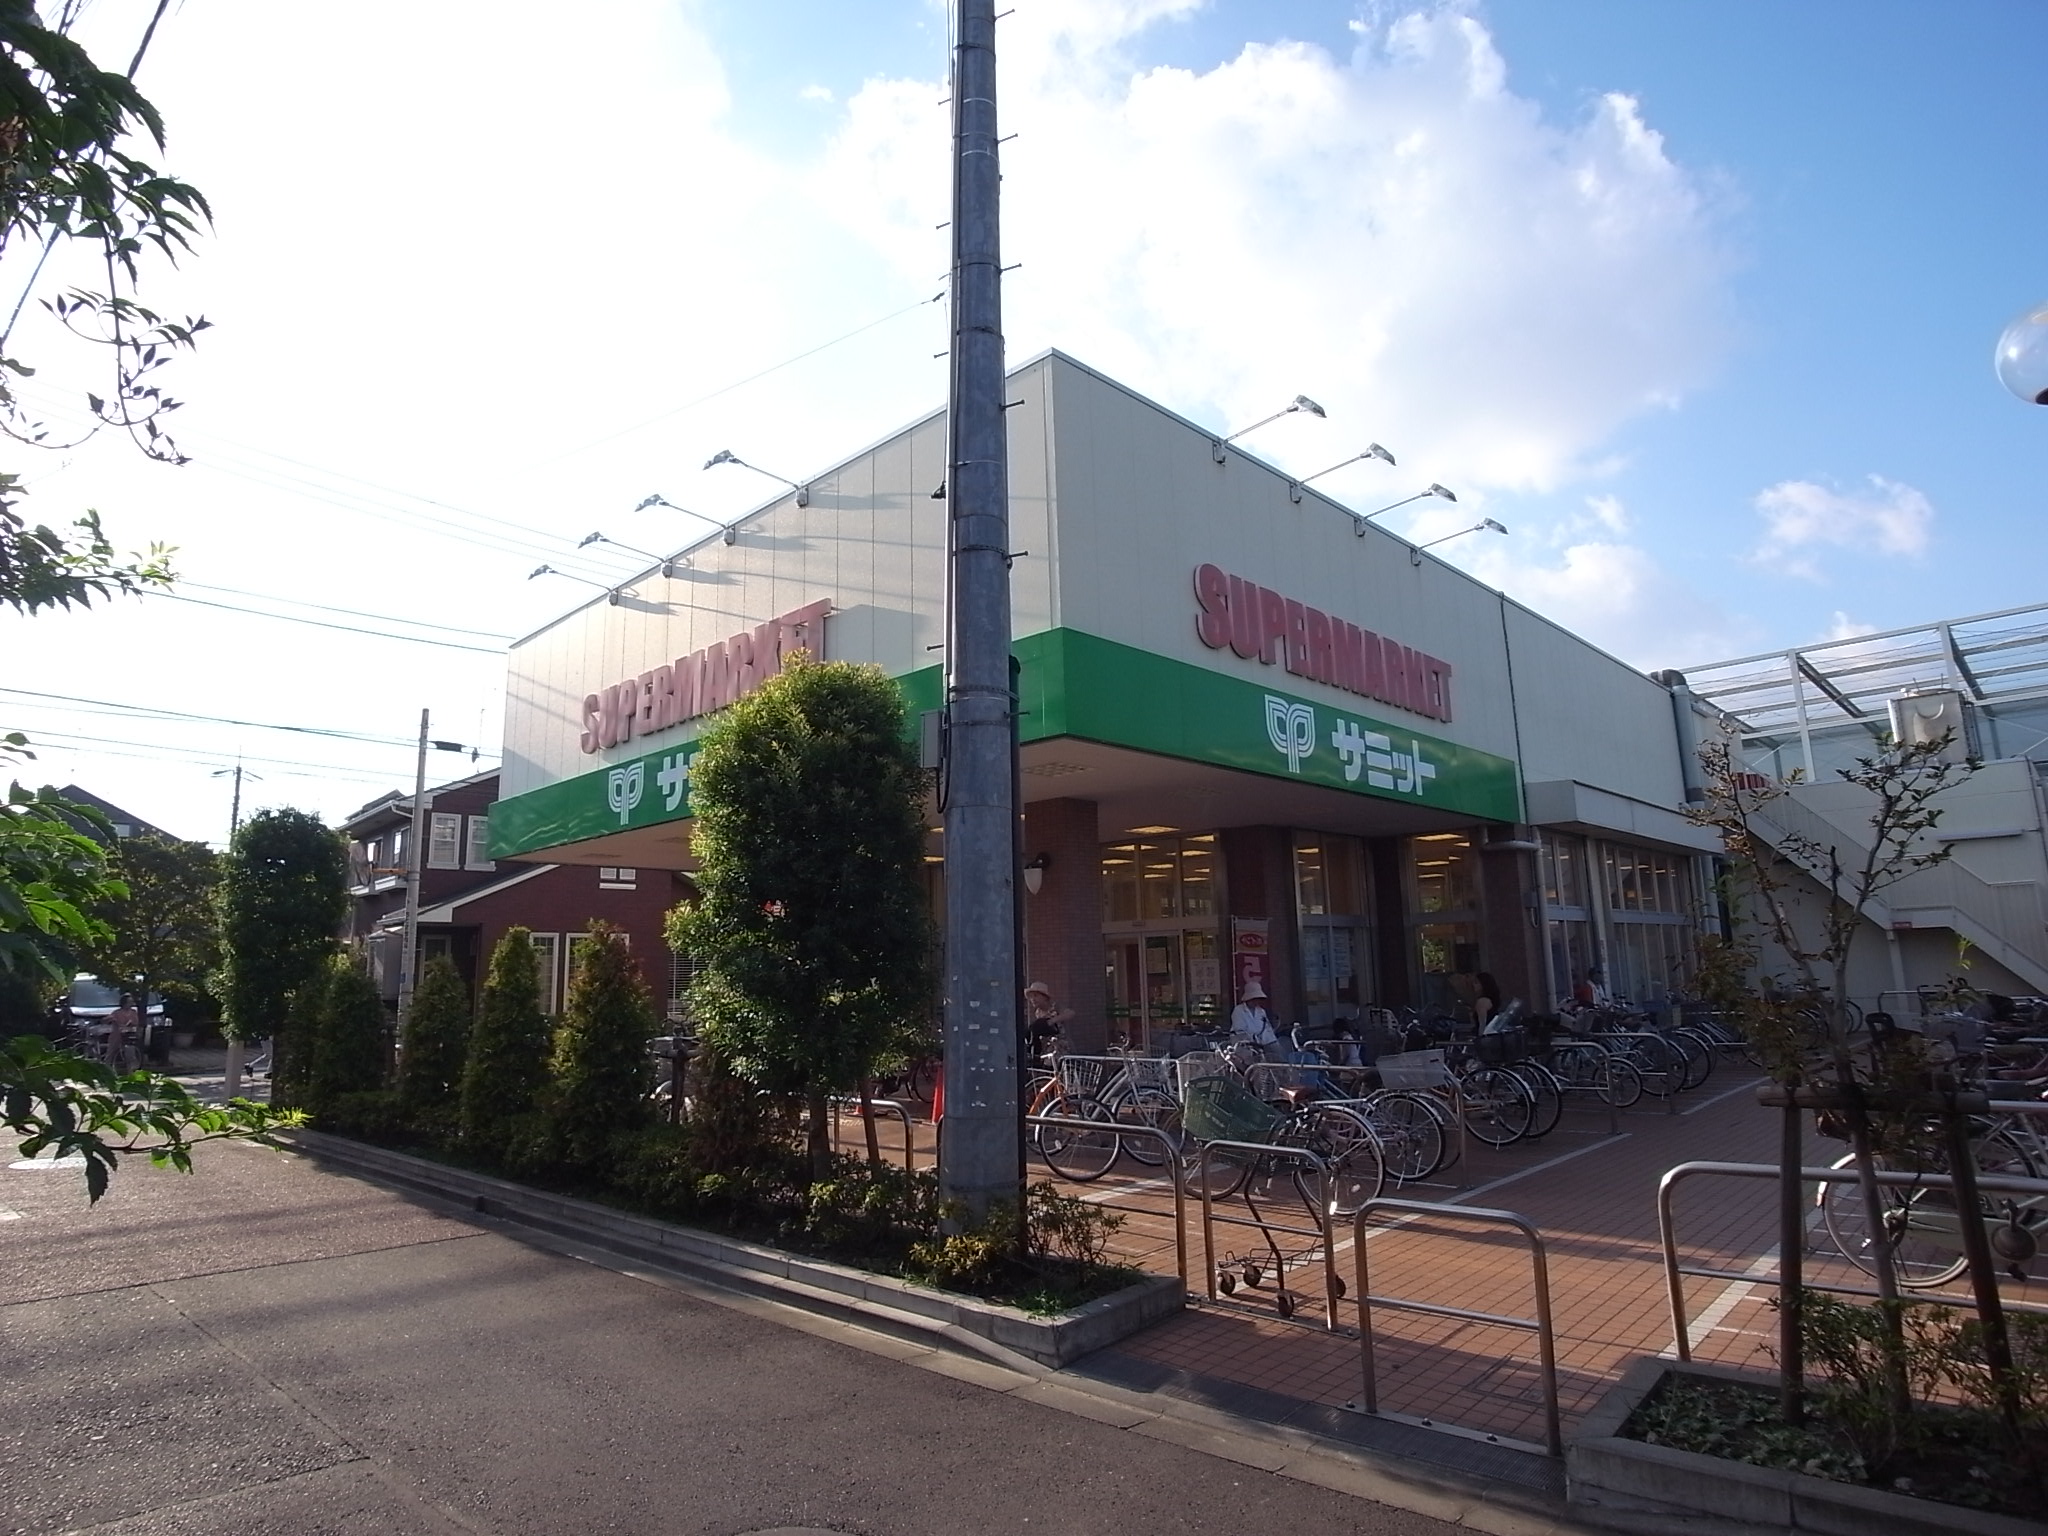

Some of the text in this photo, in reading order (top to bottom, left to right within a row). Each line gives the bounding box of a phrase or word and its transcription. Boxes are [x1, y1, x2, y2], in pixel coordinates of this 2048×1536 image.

[1194, 564, 1452, 723] SUPERMARKET
[657, 752, 694, 812] サ
[1332, 718, 1437, 797] サミット
